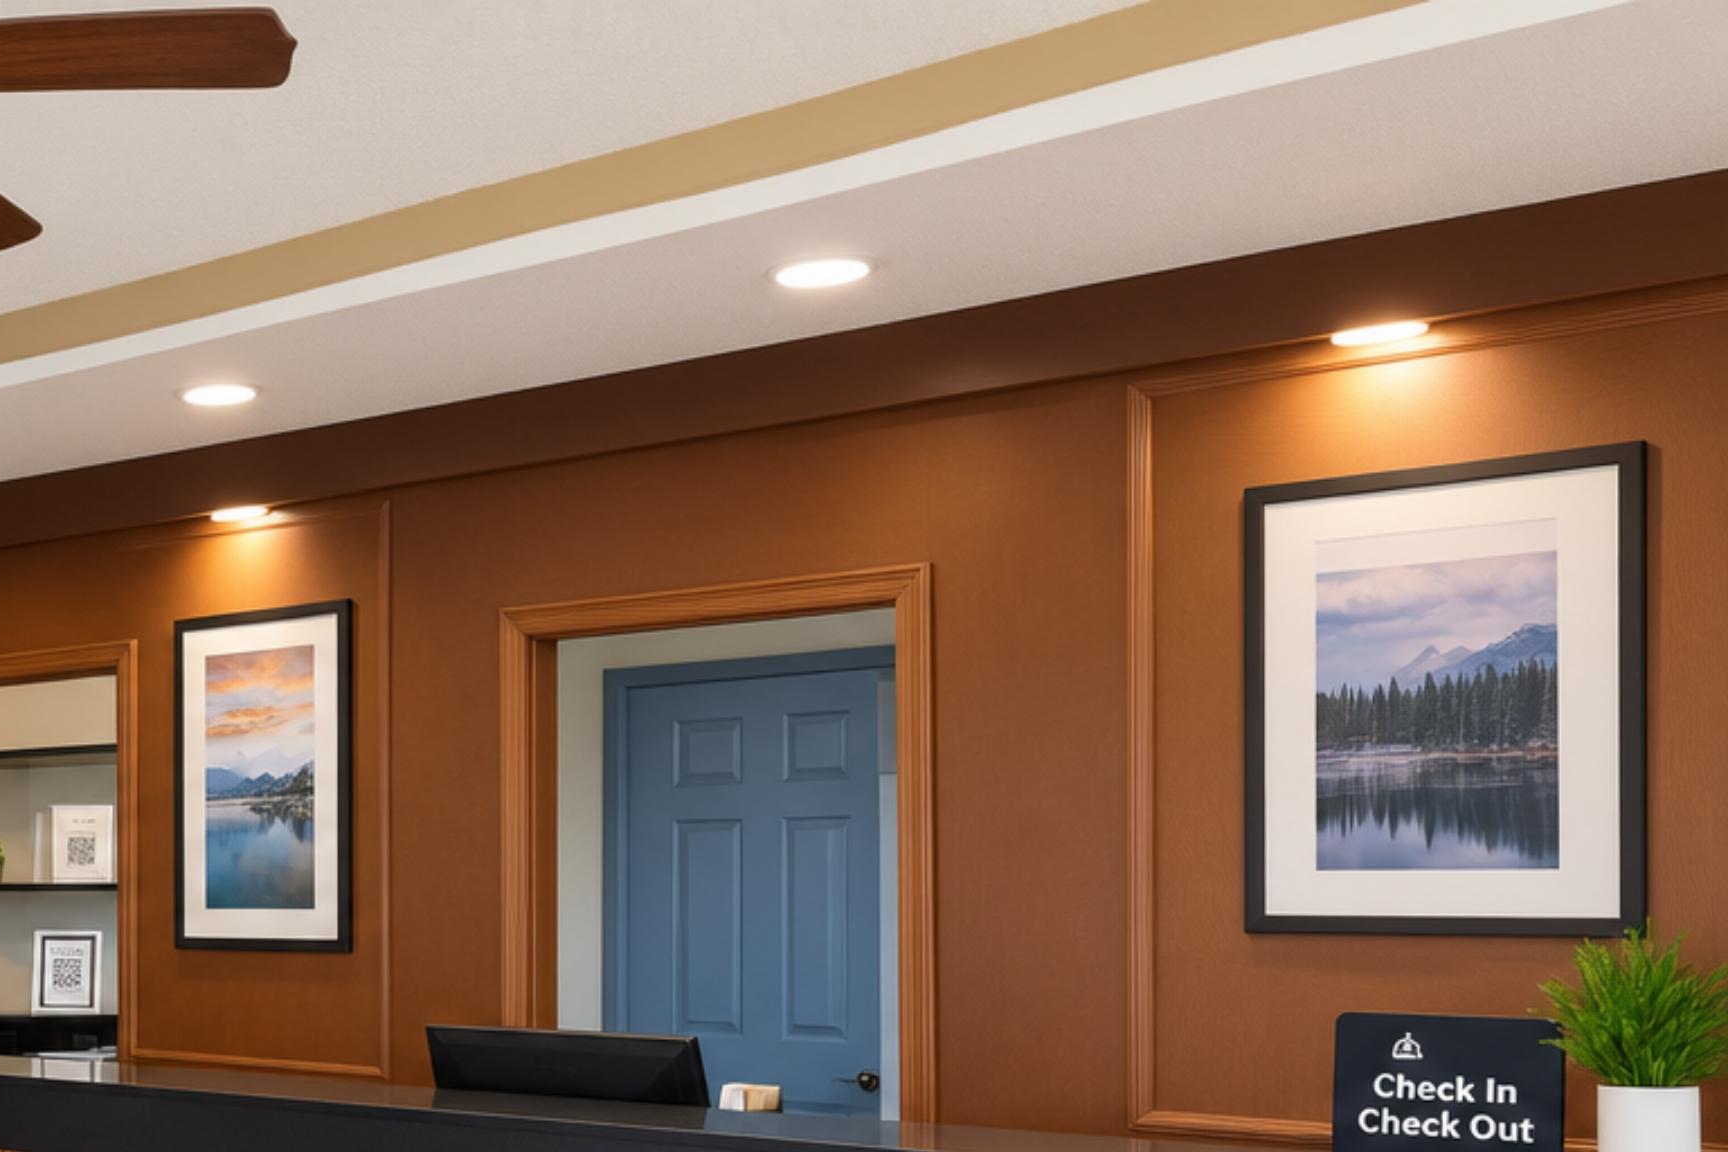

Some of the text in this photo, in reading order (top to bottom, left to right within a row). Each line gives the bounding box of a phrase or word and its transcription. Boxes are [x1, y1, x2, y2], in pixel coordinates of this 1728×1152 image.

[1373, 1073, 1518, 1104] Check In
[1358, 1107, 1535, 1144] Check Out
